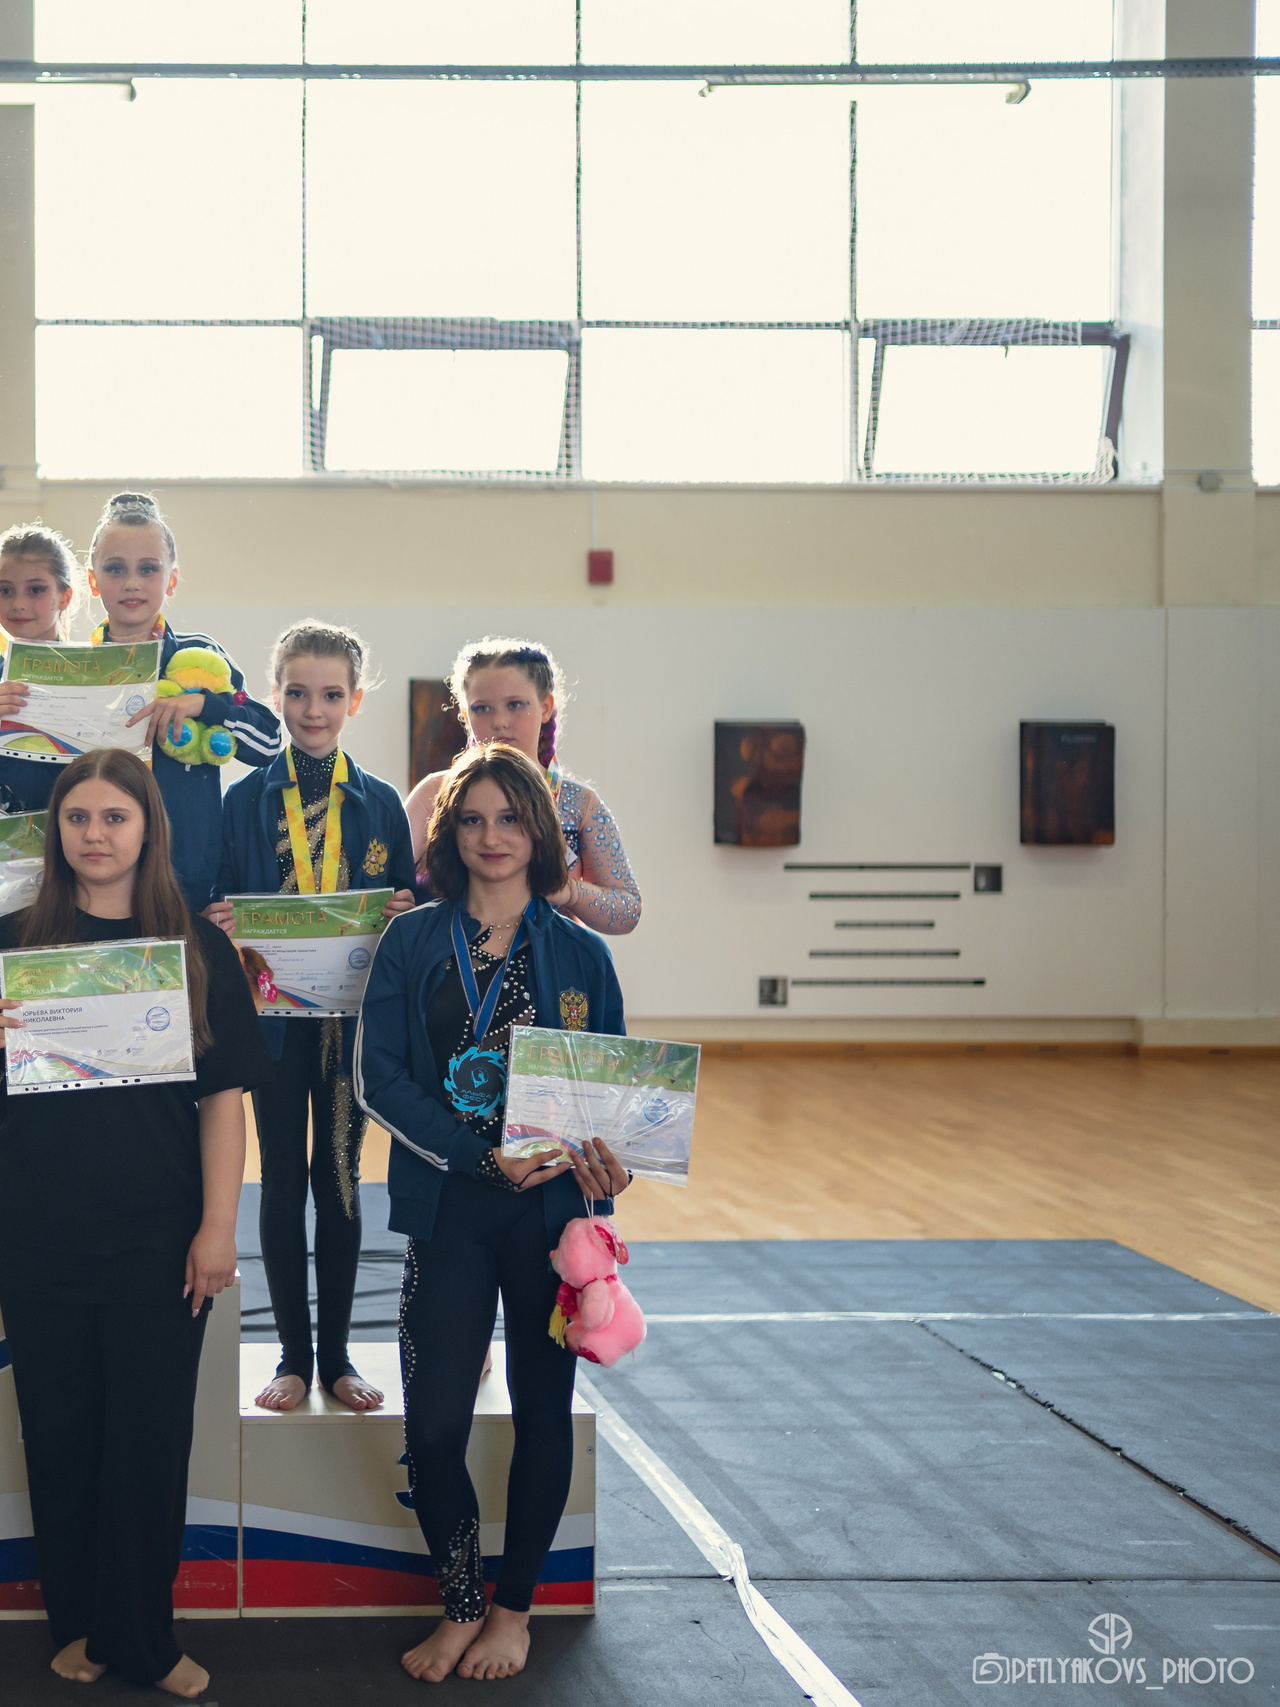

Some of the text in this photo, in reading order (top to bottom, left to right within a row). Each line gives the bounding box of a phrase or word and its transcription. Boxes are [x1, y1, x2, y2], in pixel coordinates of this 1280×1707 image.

[22, 657, 101, 673] ГРАМОТА
[241, 911, 328, 926] ГРАМОТА
[23, 1007, 83, 1017] ЮРЬЕВА ВИКТОРИЯ
[23, 1015, 66, 1023] НИКОЛАЕВНА
